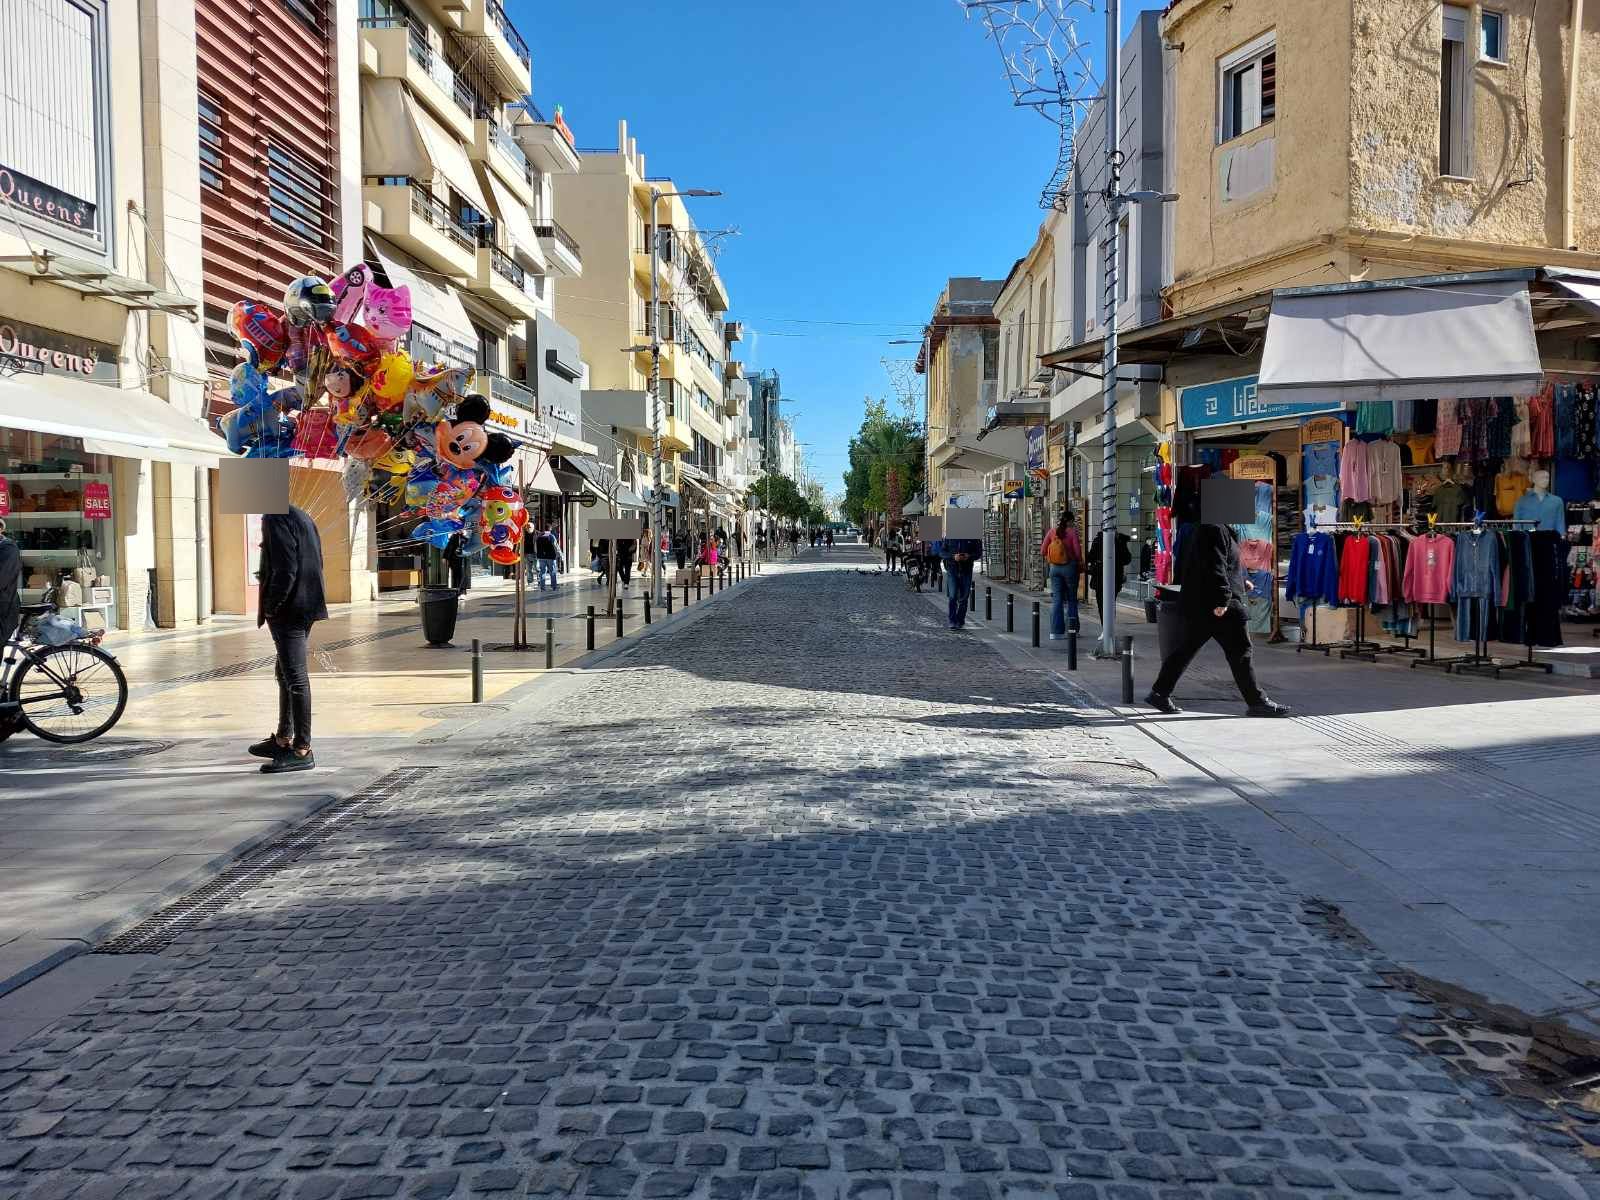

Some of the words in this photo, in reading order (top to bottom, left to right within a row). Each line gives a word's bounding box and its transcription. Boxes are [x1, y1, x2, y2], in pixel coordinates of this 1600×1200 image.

[0, 170, 81, 225] Queens
[0, 325, 95, 374] Queens
[86, 497, 109, 508] SALE
